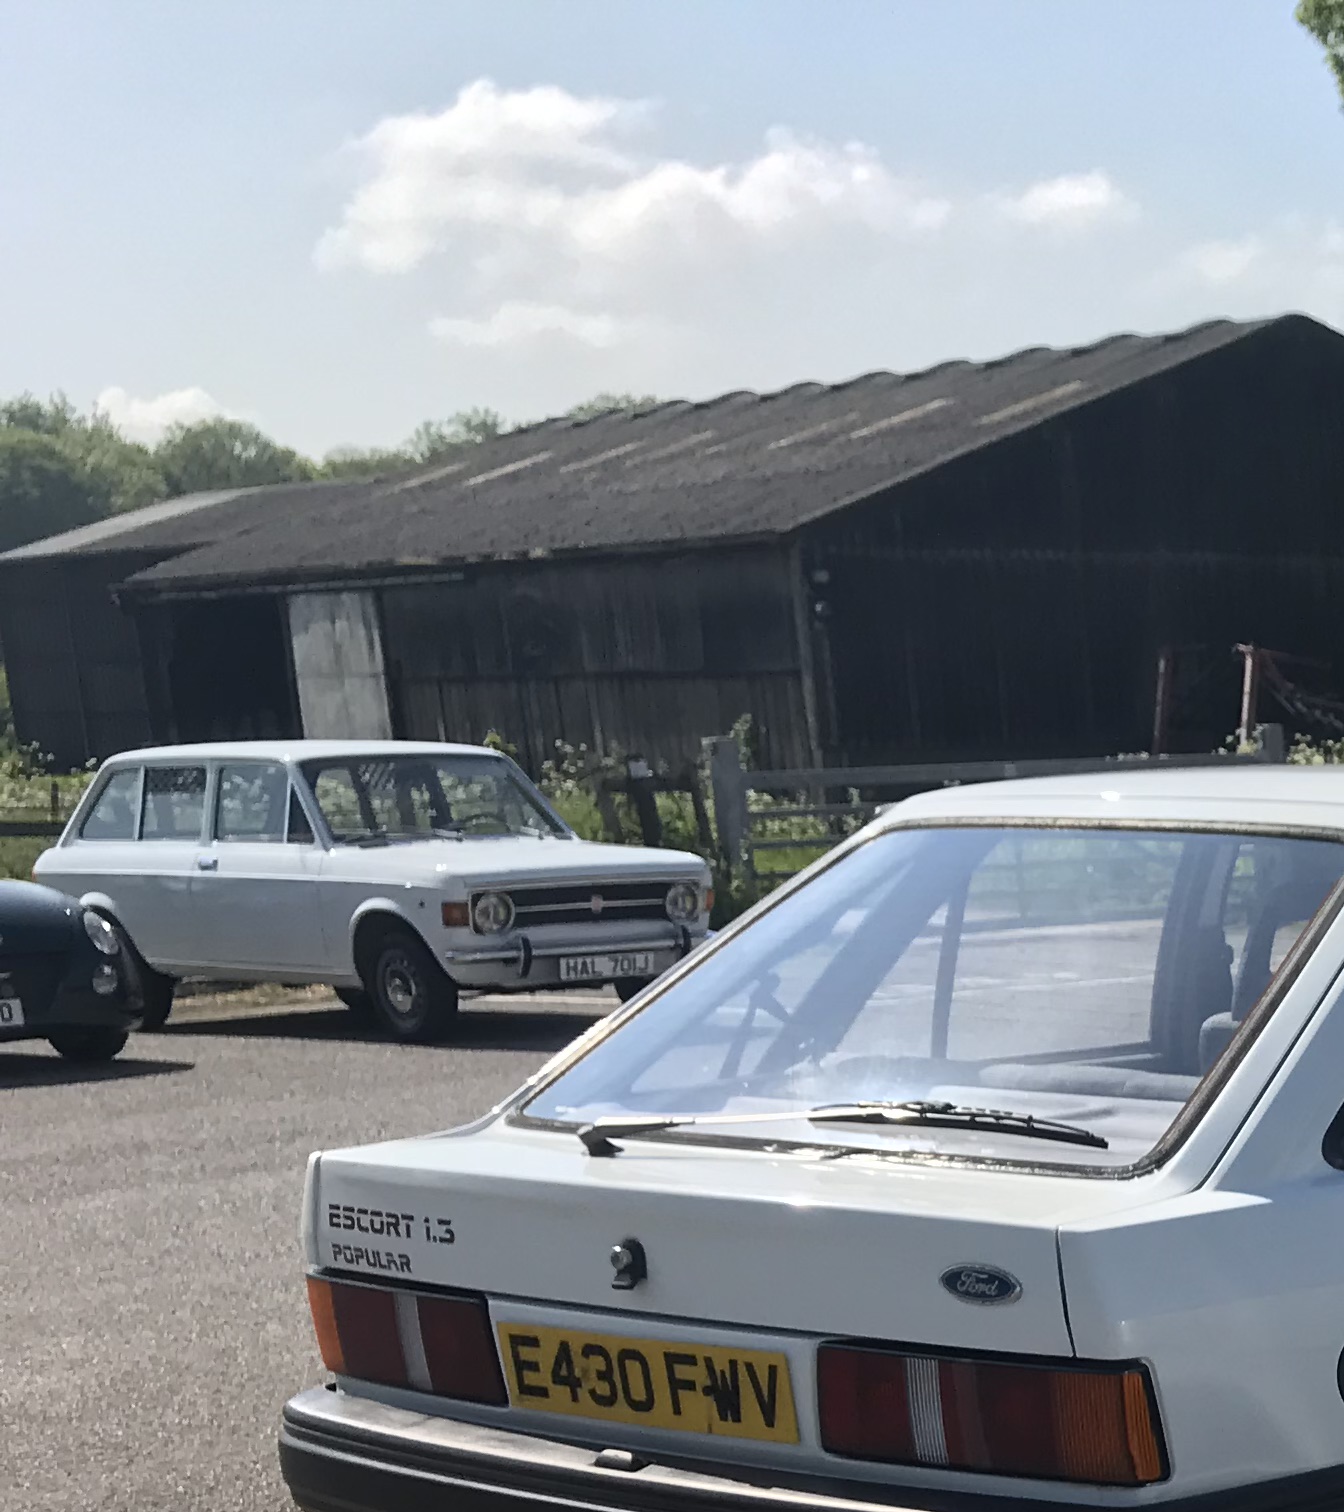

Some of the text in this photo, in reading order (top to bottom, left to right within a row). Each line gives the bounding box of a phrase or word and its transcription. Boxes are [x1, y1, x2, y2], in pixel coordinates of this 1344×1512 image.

[565, 954, 650, 977] HAL 701J
[328, 1203, 455, 1245] ESCORT 1.3
[331, 1242, 413, 1273] POPULAR
[957, 1270, 999, 1296] Ford
[507, 1332, 779, 1439] E430 FWV
